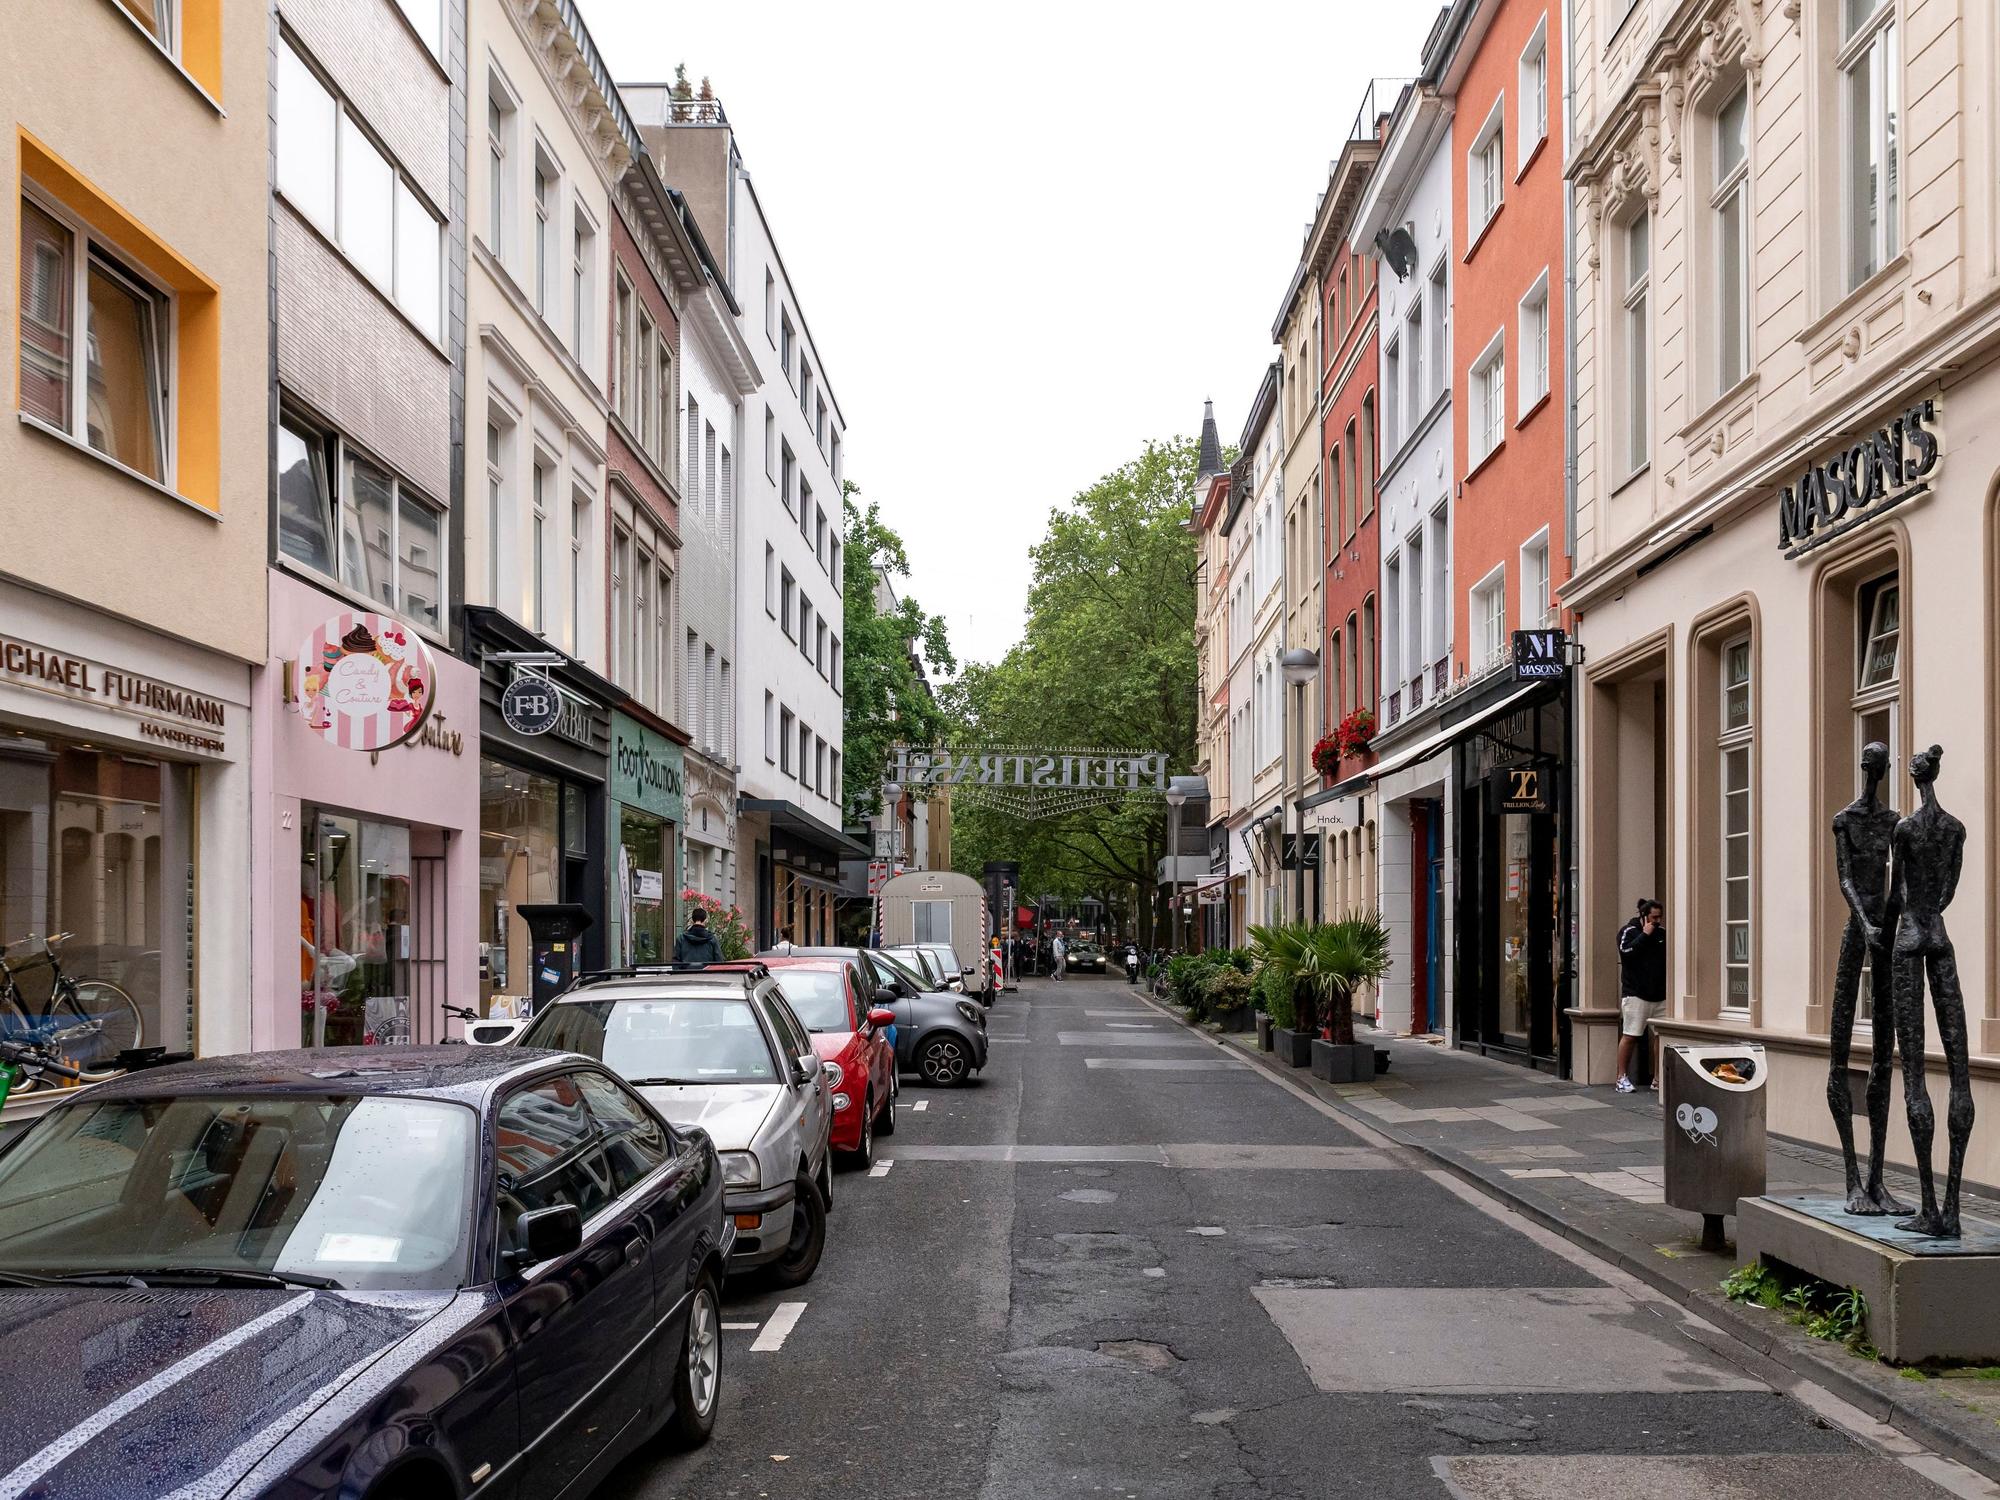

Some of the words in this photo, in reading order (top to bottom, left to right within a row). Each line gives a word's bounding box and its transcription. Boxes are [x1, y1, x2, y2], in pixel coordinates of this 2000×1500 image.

[1777, 400, 1938, 550] MASON'S
[1528, 634, 1554, 658] M
[340, 661, 379, 682] Candy
[1520, 664, 1563, 674] MASON'S
[355, 679, 367, 689] &
[104, 670, 224, 726] FUHRMANN
[335, 689, 382, 704] Couture
[513, 695, 550, 716] F&B
[140, 722, 225, 752] HAARDESIGN
[1317, 815, 1344, 824] Hndx.
